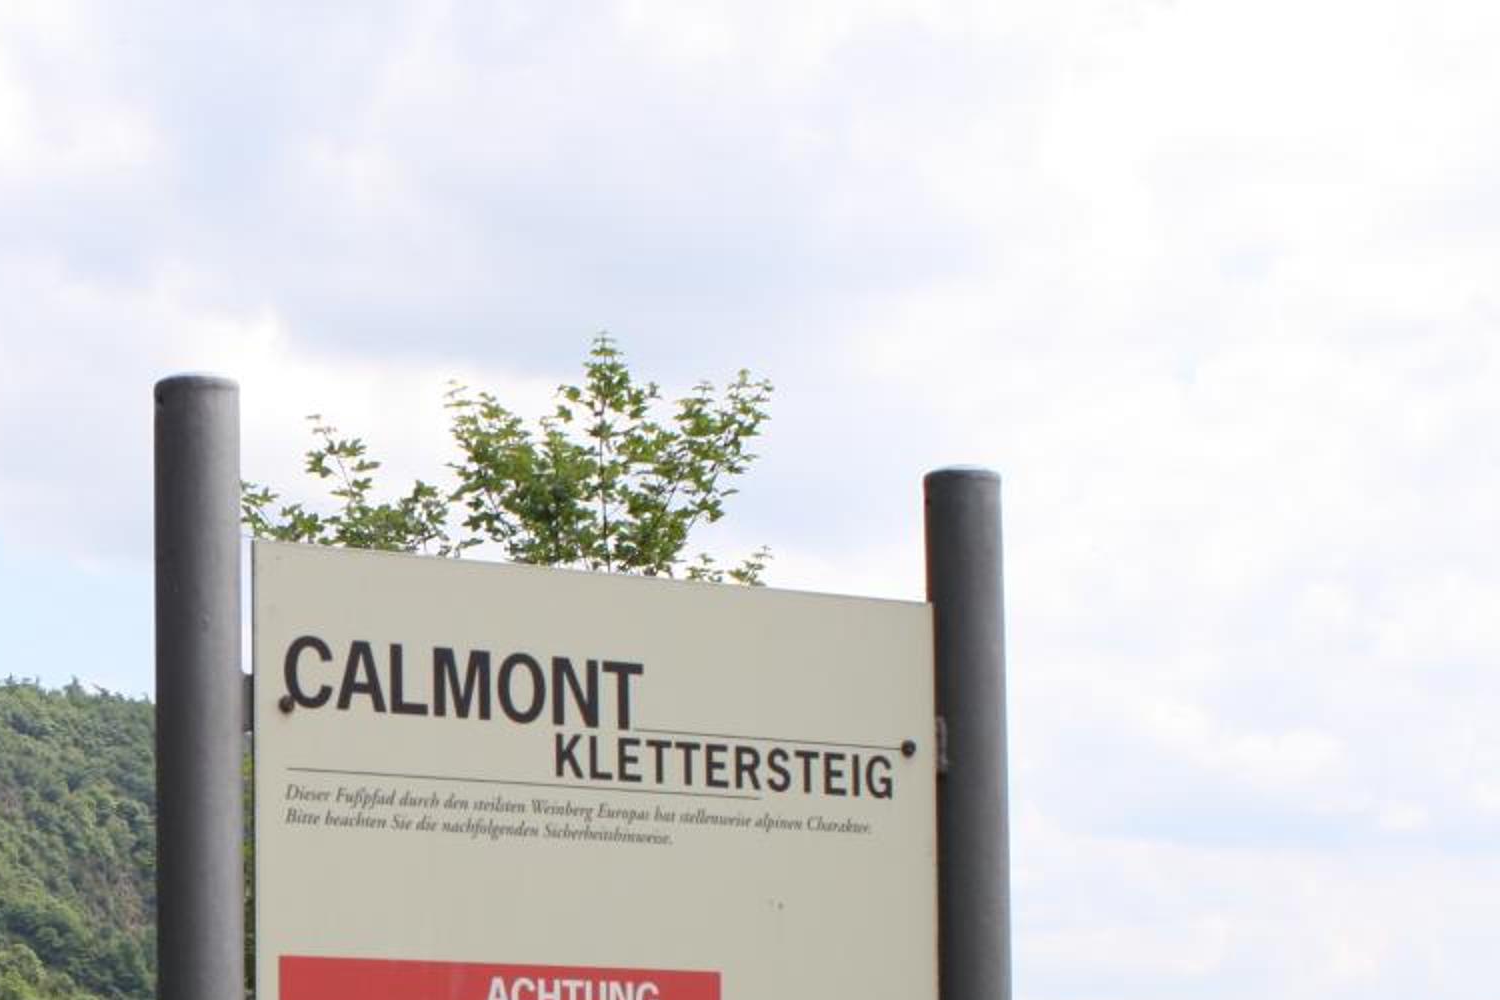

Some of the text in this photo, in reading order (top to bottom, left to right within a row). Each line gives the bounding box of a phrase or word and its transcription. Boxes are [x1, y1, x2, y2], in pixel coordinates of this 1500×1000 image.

[283, 635, 643, 730] CALMONT
[554, 733, 894, 799] KLETTERSTEIG
[285, 784, 331, 802] Dieser
[399, 791, 439, 808] durch
[443, 792, 469, 810] den
[473, 794, 525, 813] steilsten
[531, 798, 593, 824] Weinberg
[597, 803, 649, 826] Europas
[654, 805, 677, 822] hat
[679, 808, 753, 828] stellenweise
[755, 812, 803, 833] alpinen
[285, 808, 321, 825] Bitte
[324, 810, 388, 829] beachten
[390, 814, 411, 831] Sie
[414, 815, 438, 832] die
[441, 817, 539, 841] nachfolgenden
